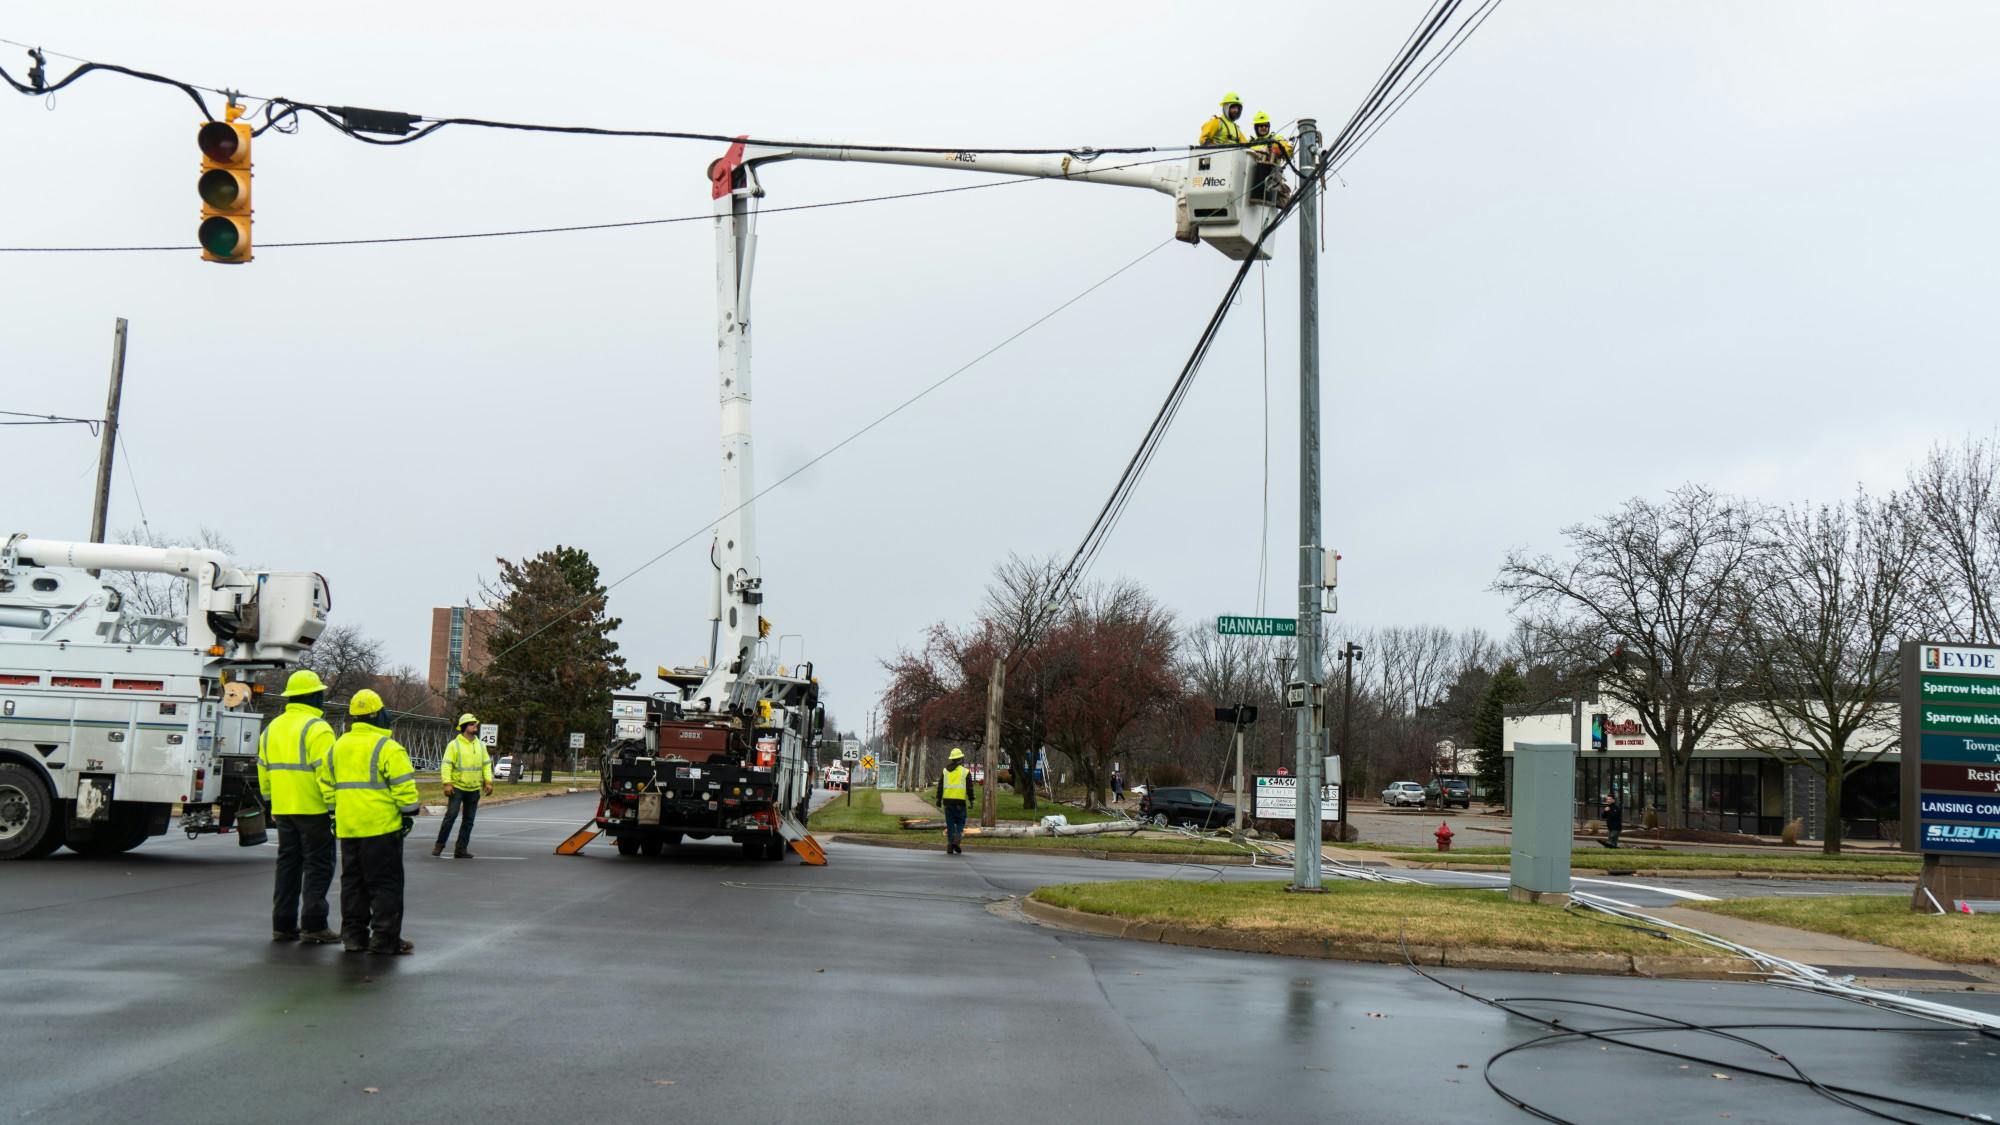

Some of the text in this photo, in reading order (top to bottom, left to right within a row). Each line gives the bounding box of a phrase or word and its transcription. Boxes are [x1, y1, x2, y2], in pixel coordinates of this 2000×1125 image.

[1203, 177, 1226, 187] Altec
[1220, 618, 1294, 634] HANNAH BLVD
[1943, 652, 1995, 668] EYDE
[1923, 682, 1969, 695] Sparrow
[1926, 712, 2000, 724] Sparrow Mich
[481, 735, 496, 744] 45
[1962, 739, 2000, 752] Towne
[843, 750, 858, 759] 45
[1922, 802, 1973, 814] LANSING
[1927, 825, 2000, 840] SUBUR
